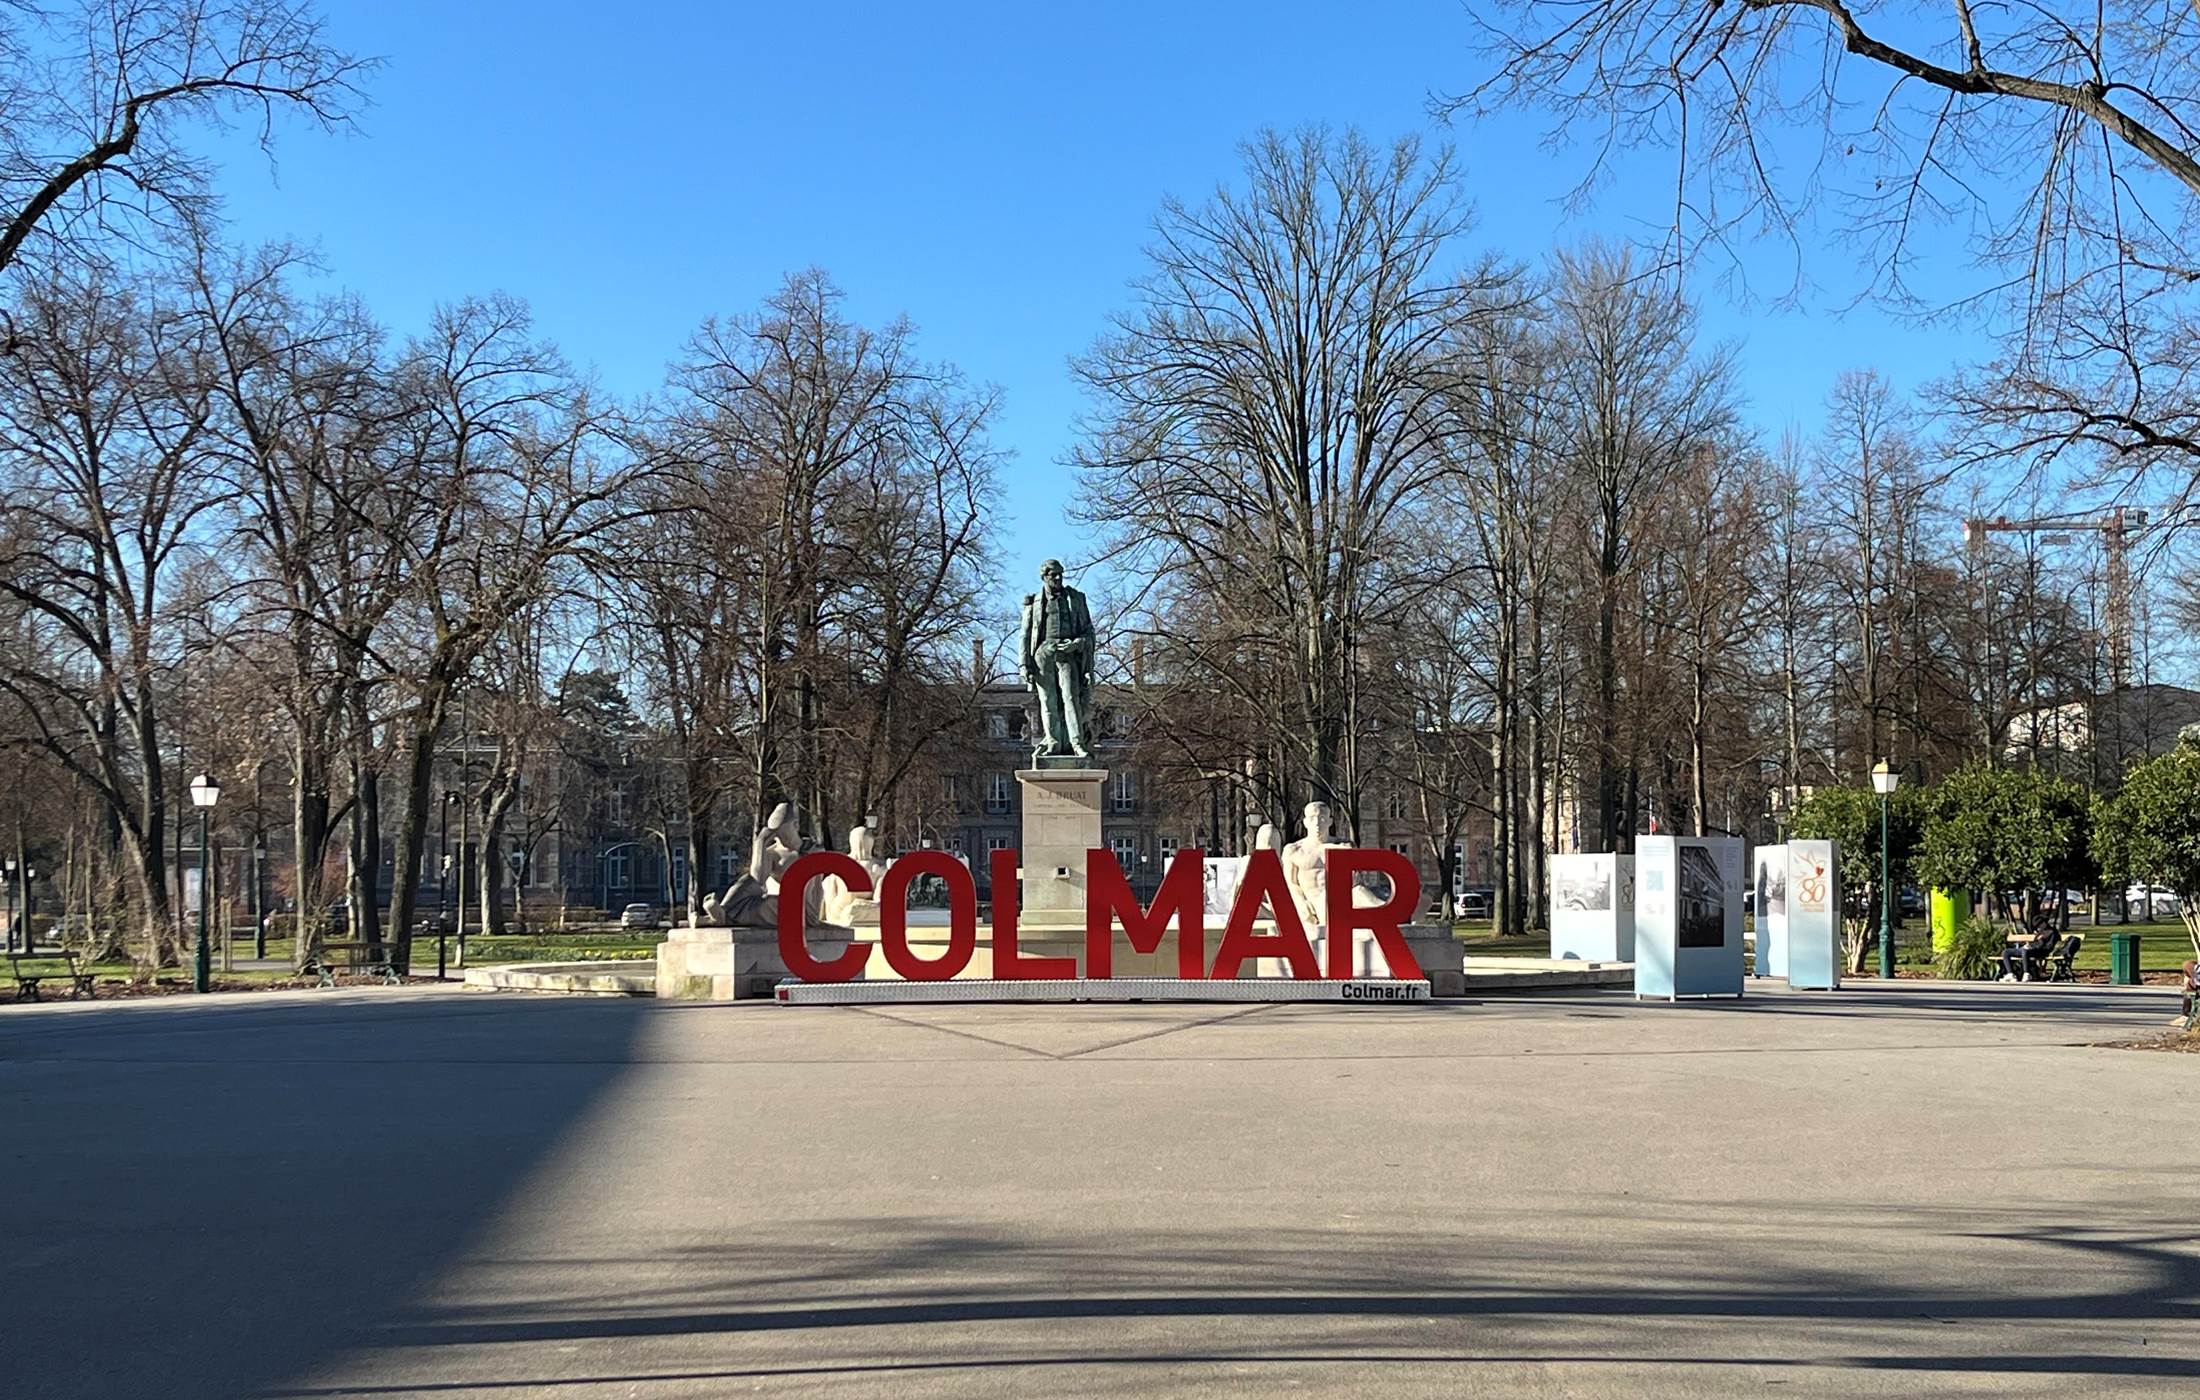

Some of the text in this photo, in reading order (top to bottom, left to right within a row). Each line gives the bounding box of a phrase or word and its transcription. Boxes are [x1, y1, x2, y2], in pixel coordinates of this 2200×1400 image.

[1799, 878, 1825, 903] 80
[778, 848, 1425, 981] COLMAR
[1342, 983, 1419, 999] Colmar.fr
